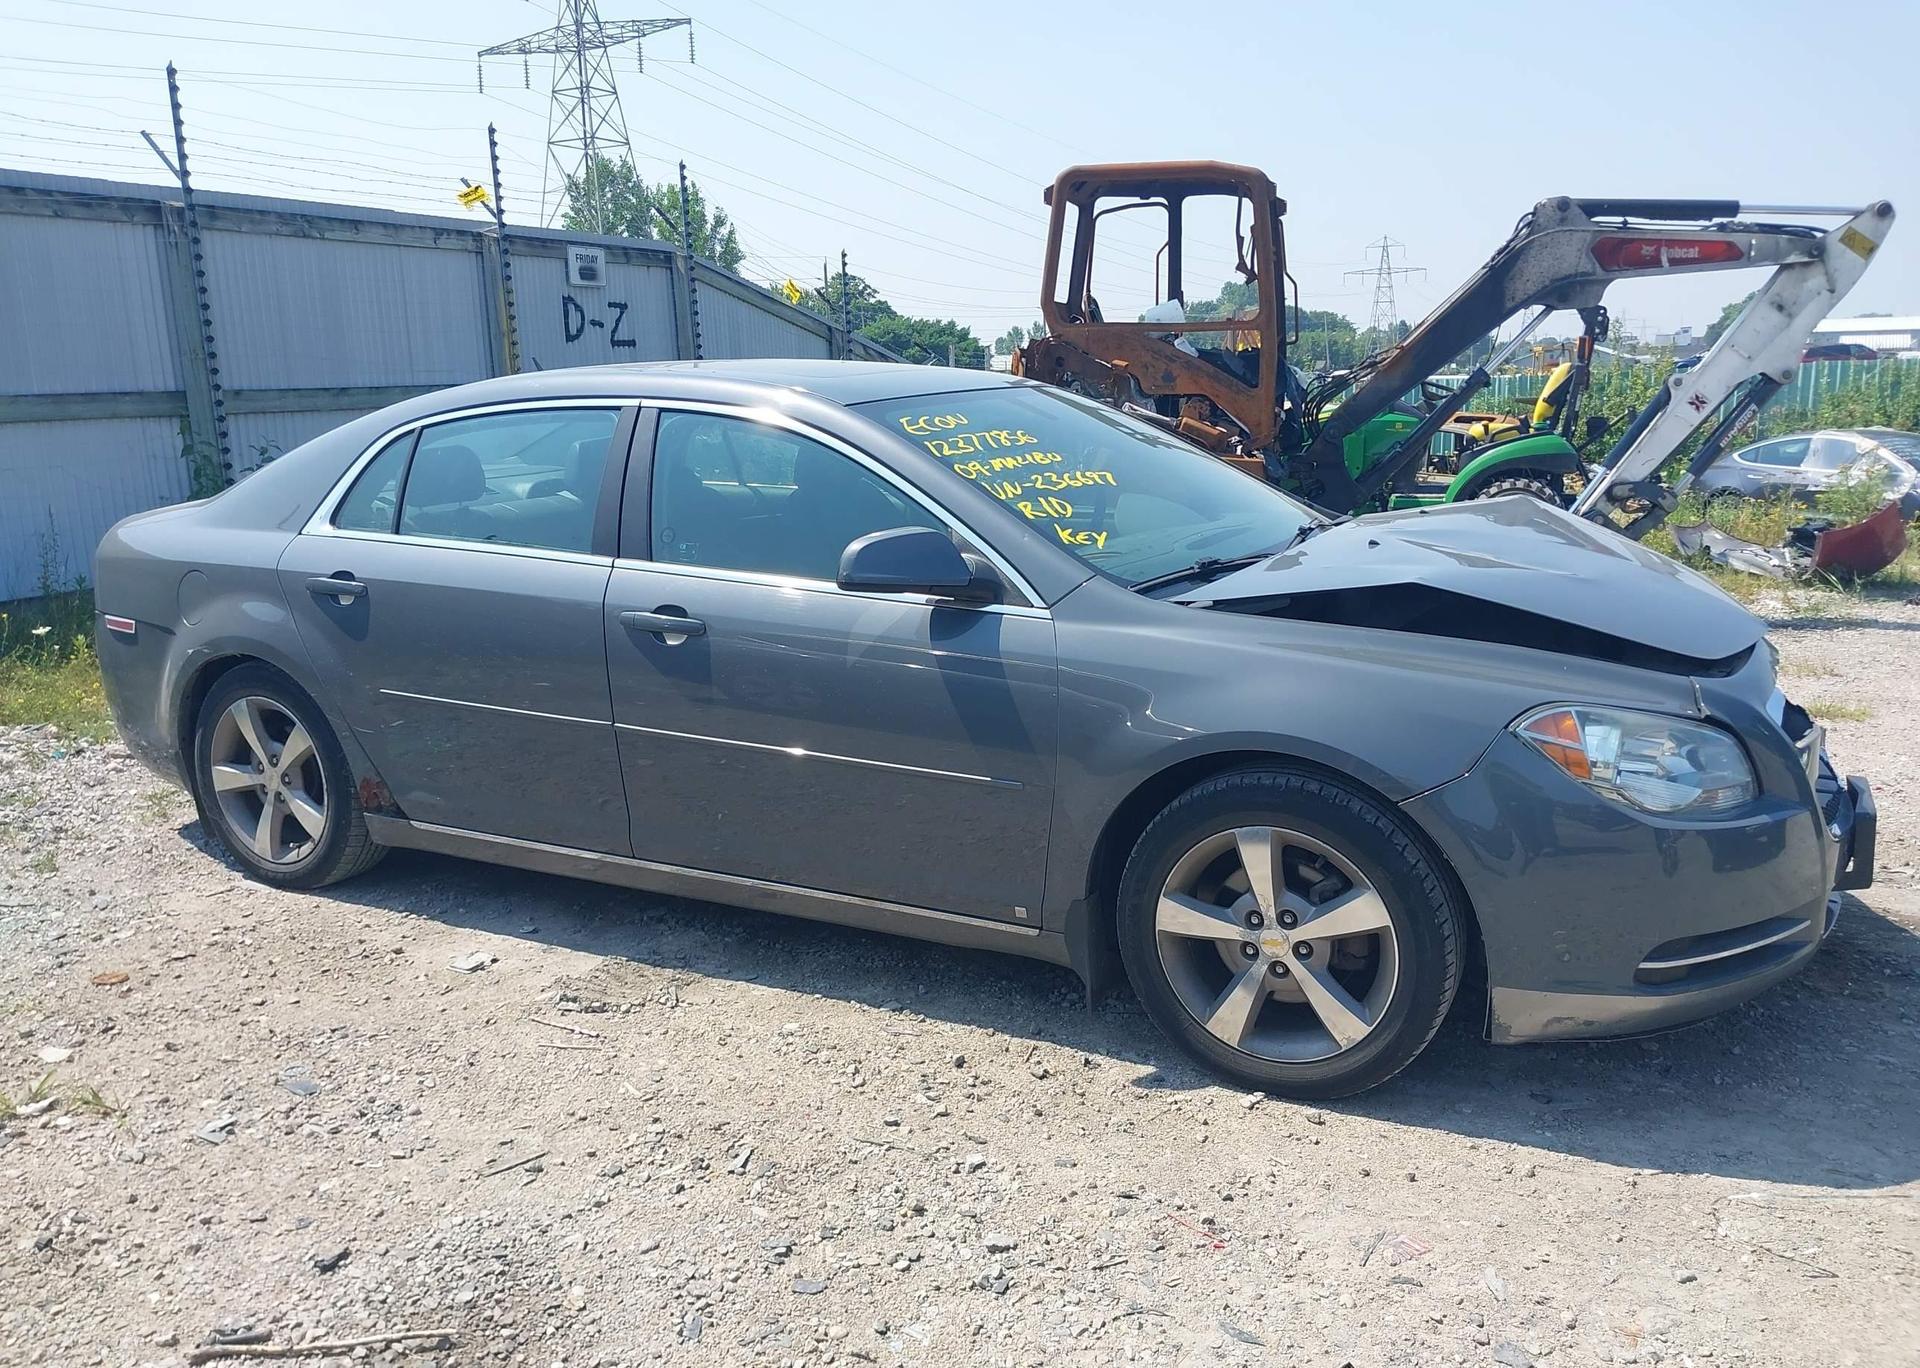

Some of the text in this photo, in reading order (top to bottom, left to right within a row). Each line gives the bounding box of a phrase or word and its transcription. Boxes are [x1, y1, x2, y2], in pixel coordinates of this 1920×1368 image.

[575, 253, 599, 265] FRIDAY
[562, 294, 637, 349] D-Z
[900, 413, 968, 435] ECON
[924, 430, 1038, 457] 12377856
